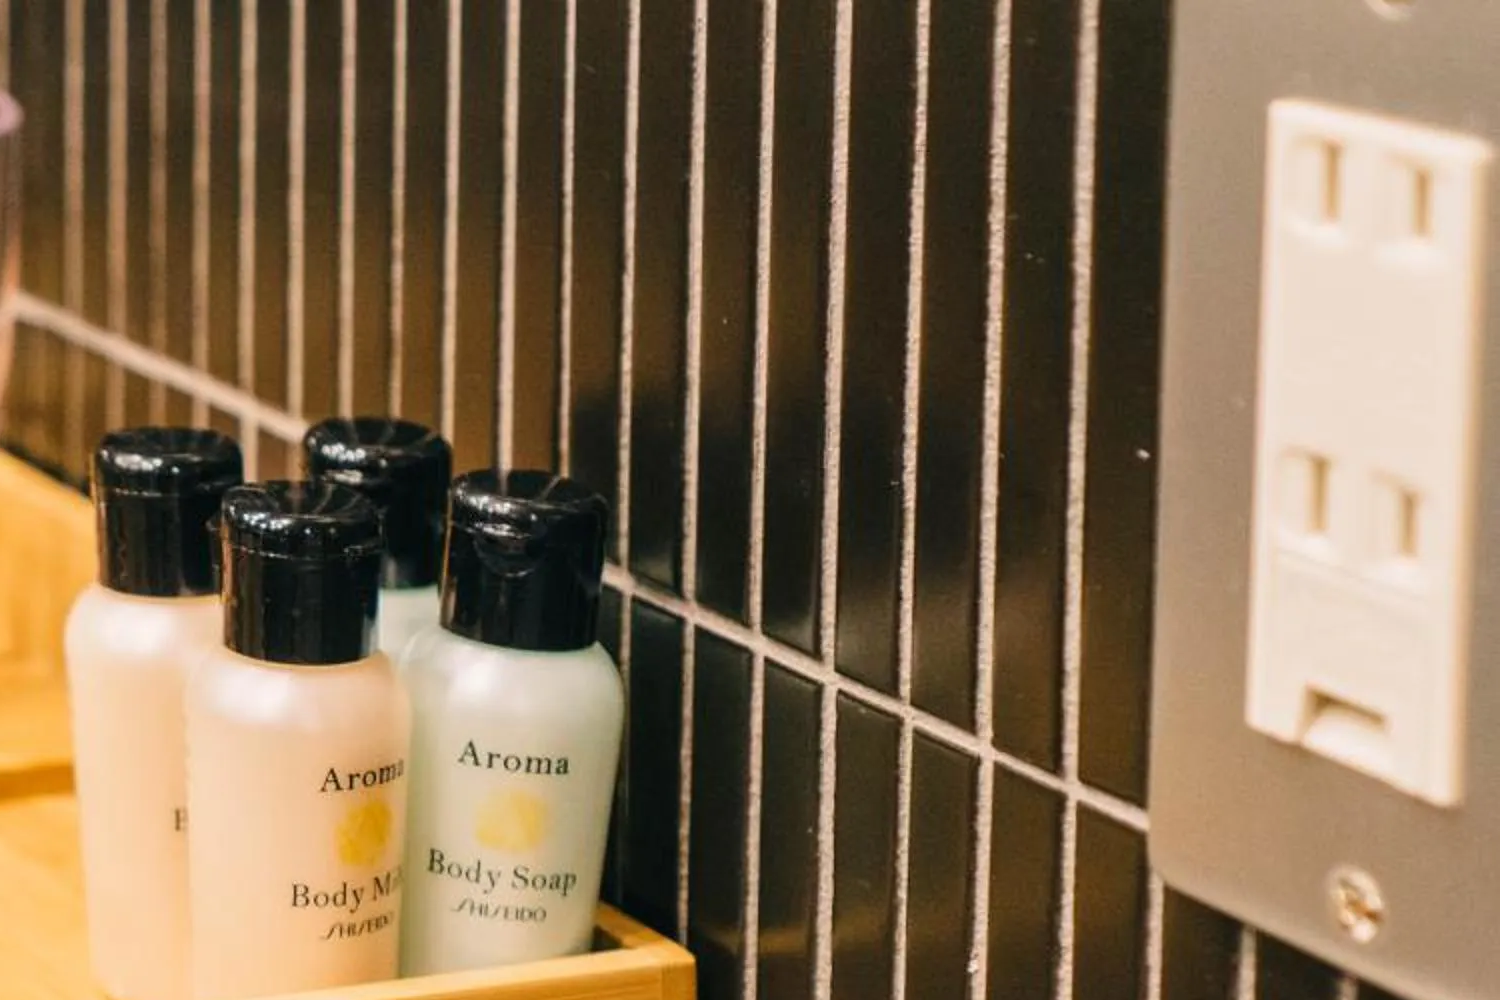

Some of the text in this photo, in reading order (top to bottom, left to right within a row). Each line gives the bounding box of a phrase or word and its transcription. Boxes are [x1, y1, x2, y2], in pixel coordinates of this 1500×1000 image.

[457, 738, 571, 776] Aroma
[426, 847, 578, 898] Body Soap
[290, 881, 365, 914] Body
[450, 896, 548, 923] SHISEIDO
